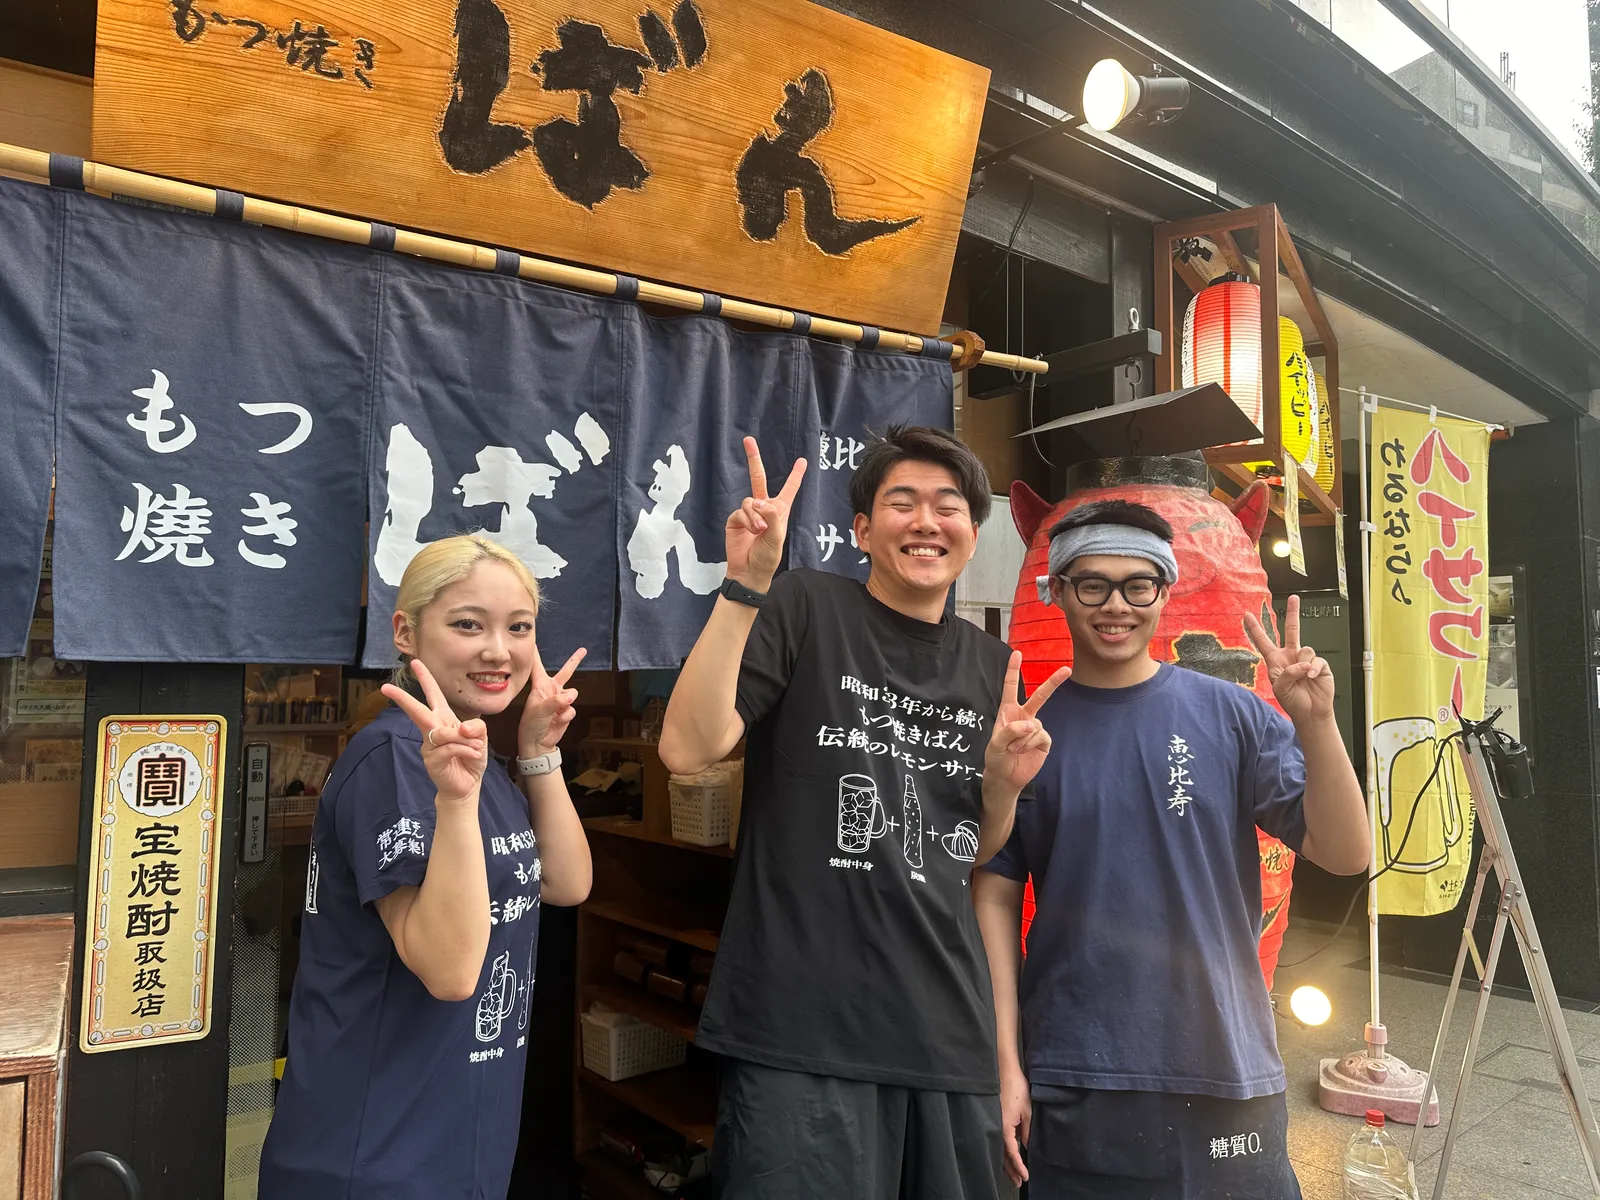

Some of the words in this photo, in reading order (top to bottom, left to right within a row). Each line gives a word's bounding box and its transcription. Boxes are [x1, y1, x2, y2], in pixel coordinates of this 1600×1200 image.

[438, 0, 923, 256] ばん
[126, 368, 313, 454] もつ
[250, 758, 264, 783] 自動
[1167, 734, 1195, 817] 恵比寿
[126, 822, 182, 1018] 宝焼酎取扱店
